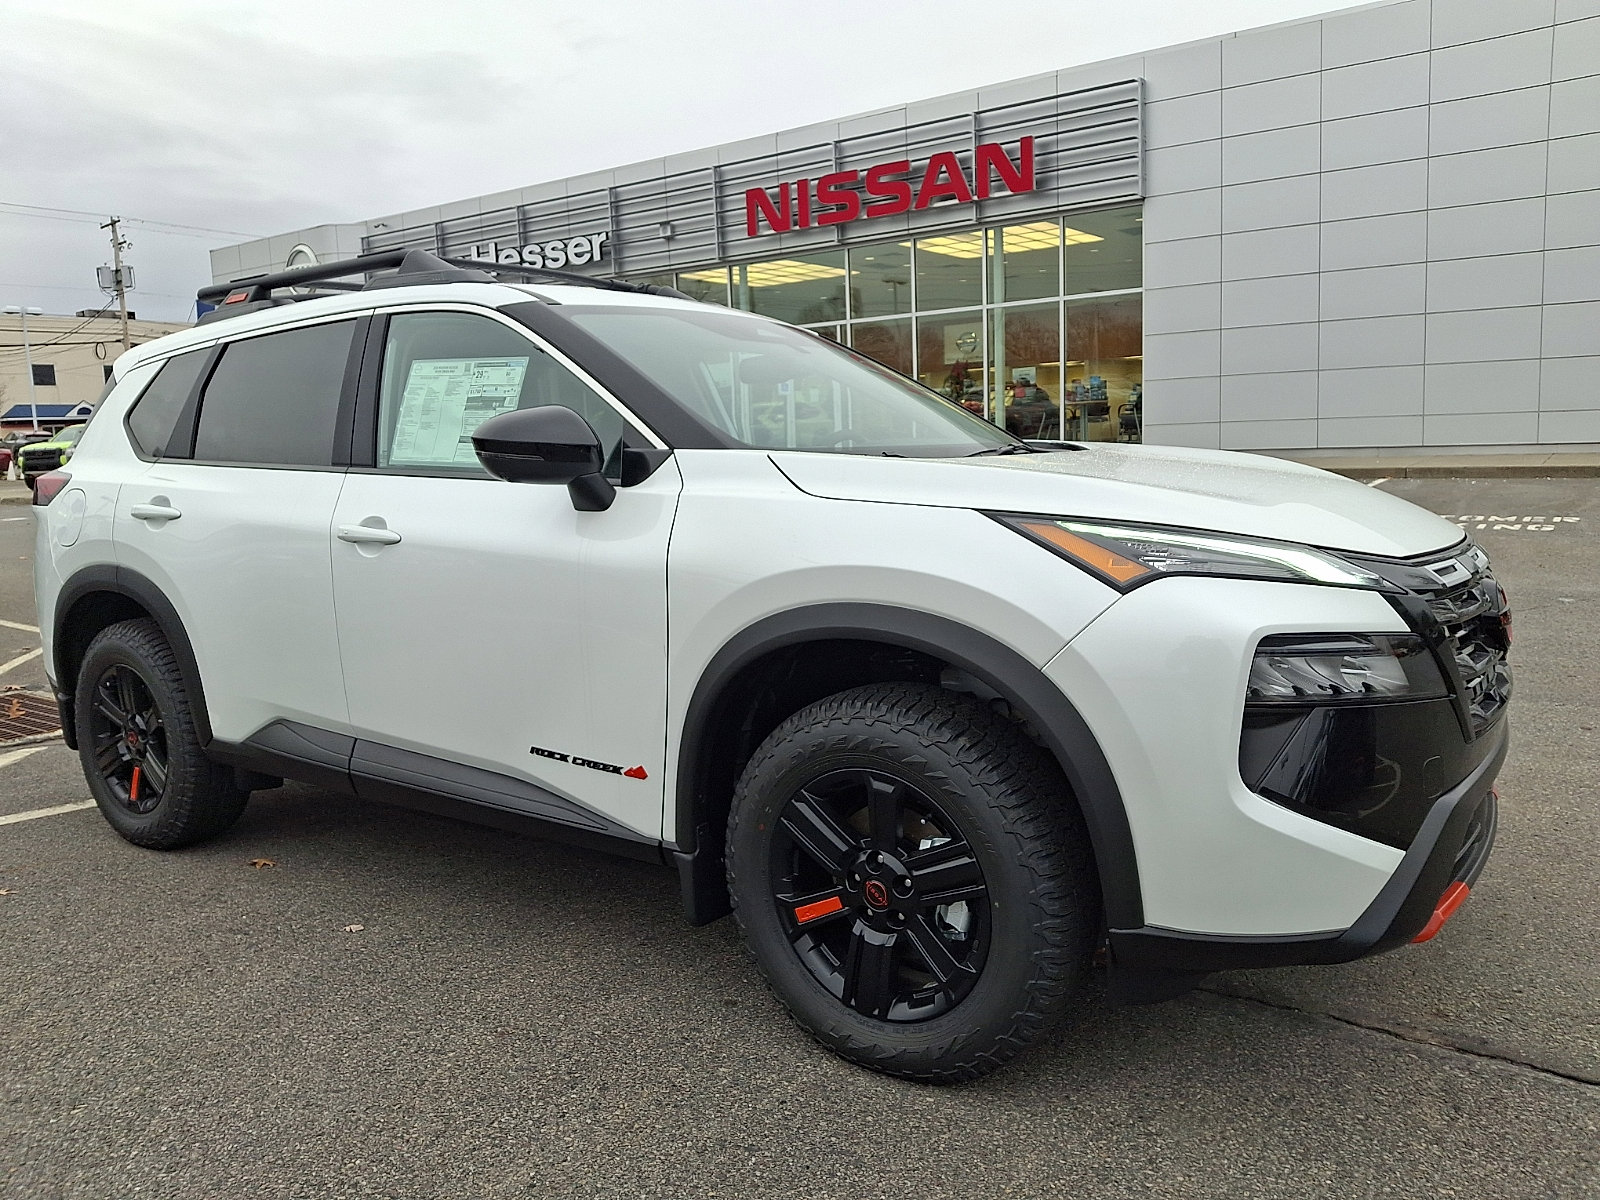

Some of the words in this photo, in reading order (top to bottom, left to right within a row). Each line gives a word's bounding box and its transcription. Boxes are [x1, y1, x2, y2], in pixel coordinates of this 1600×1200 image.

[746, 135, 1035, 237] NISSAN
[470, 231, 607, 269] Hesser
[529, 746, 571, 763] ROCK
[571, 756, 625, 776] CREEK
